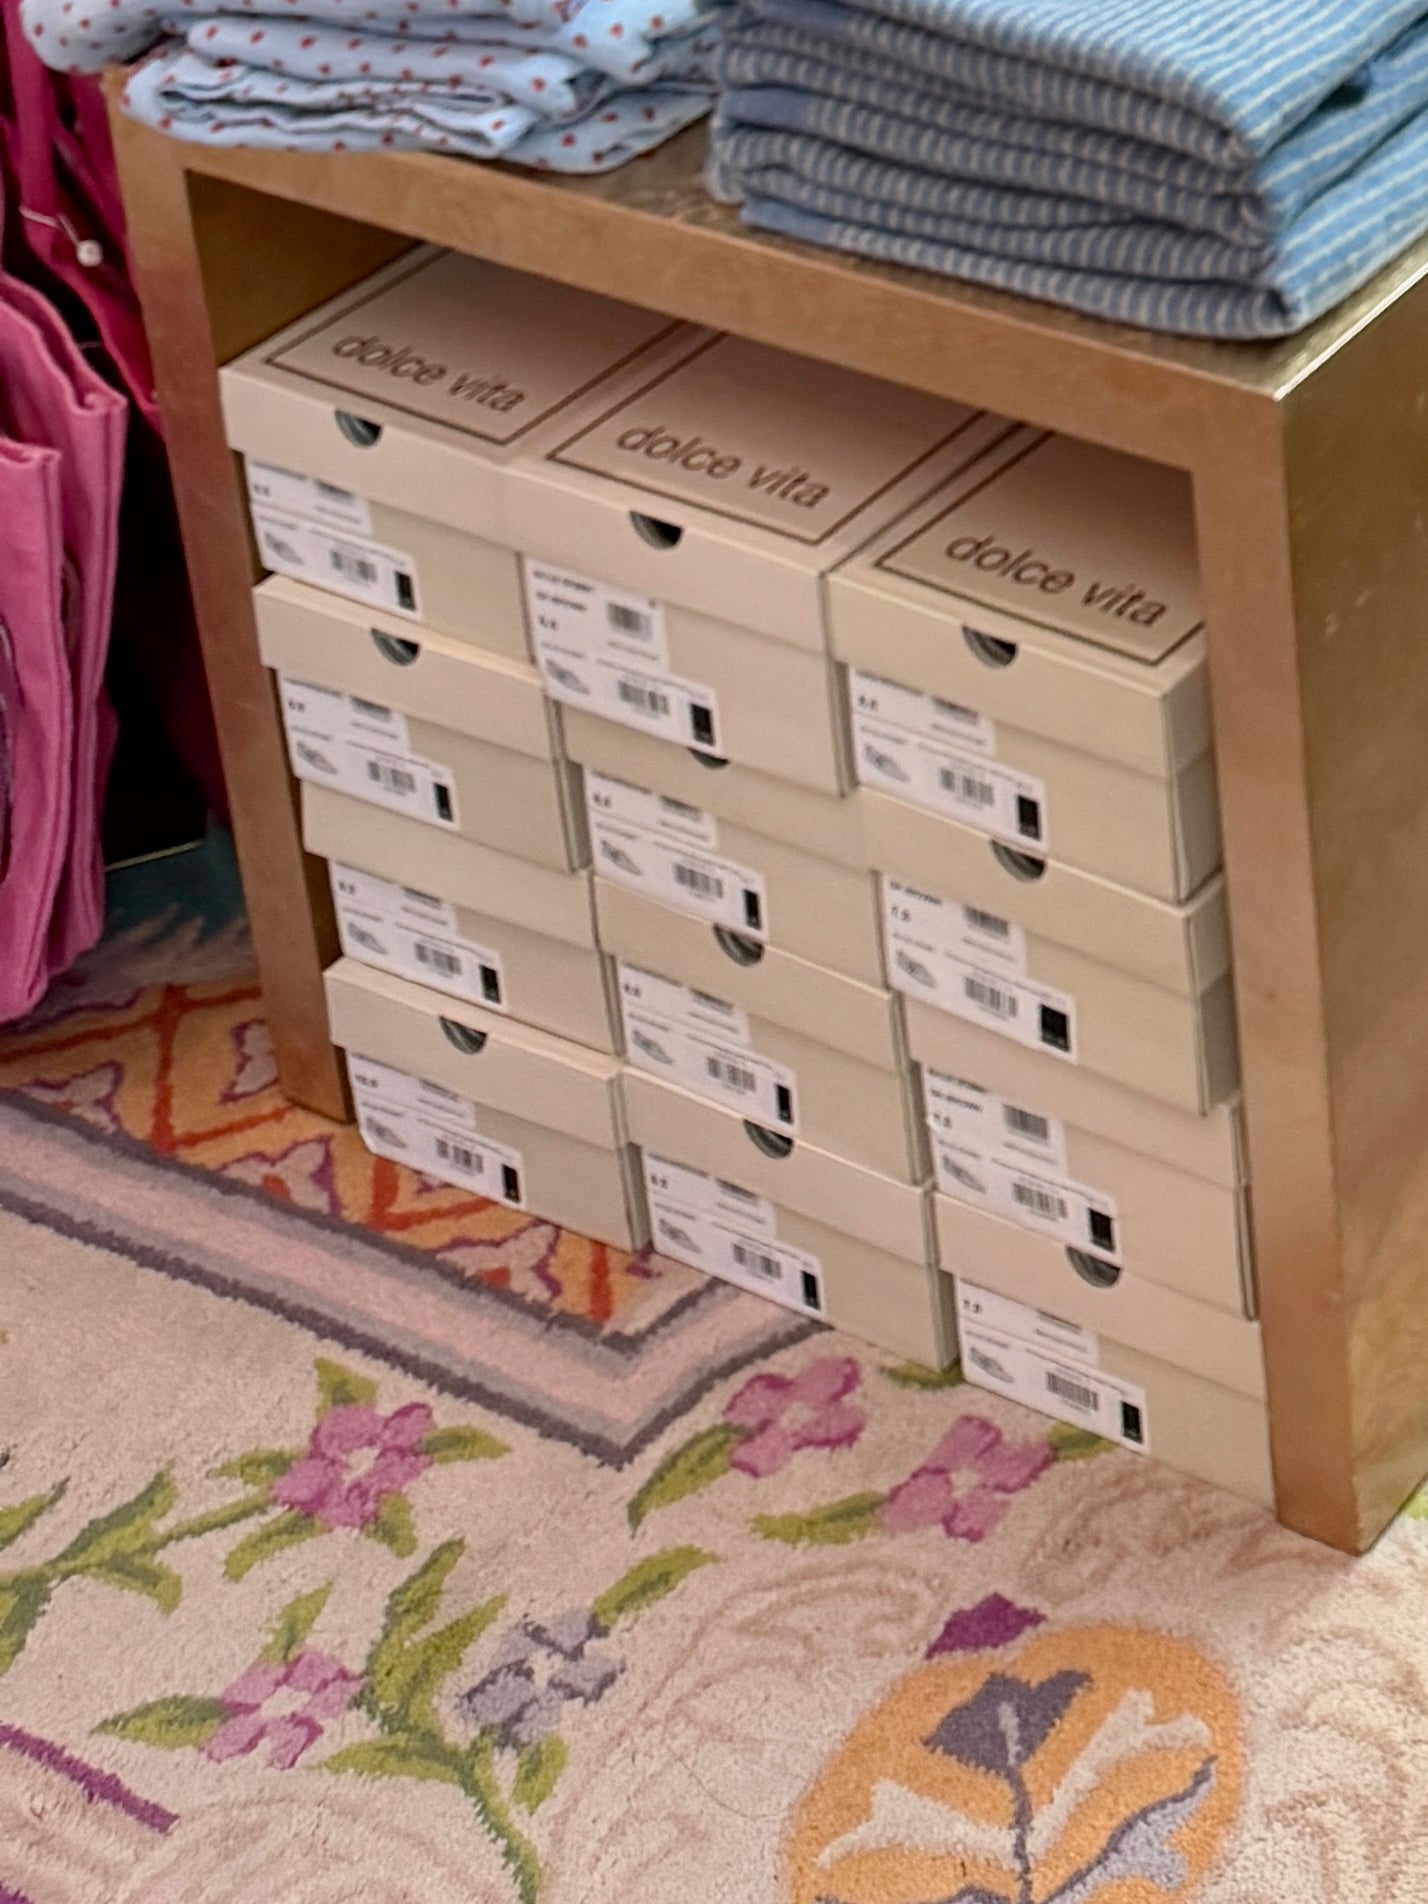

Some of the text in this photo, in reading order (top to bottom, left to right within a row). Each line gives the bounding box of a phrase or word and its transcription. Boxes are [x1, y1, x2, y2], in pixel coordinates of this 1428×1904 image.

[332, 329, 528, 415] dolce vita
[616, 423, 832, 511] dolce vita
[944, 529, 1170, 630] dolce vita
